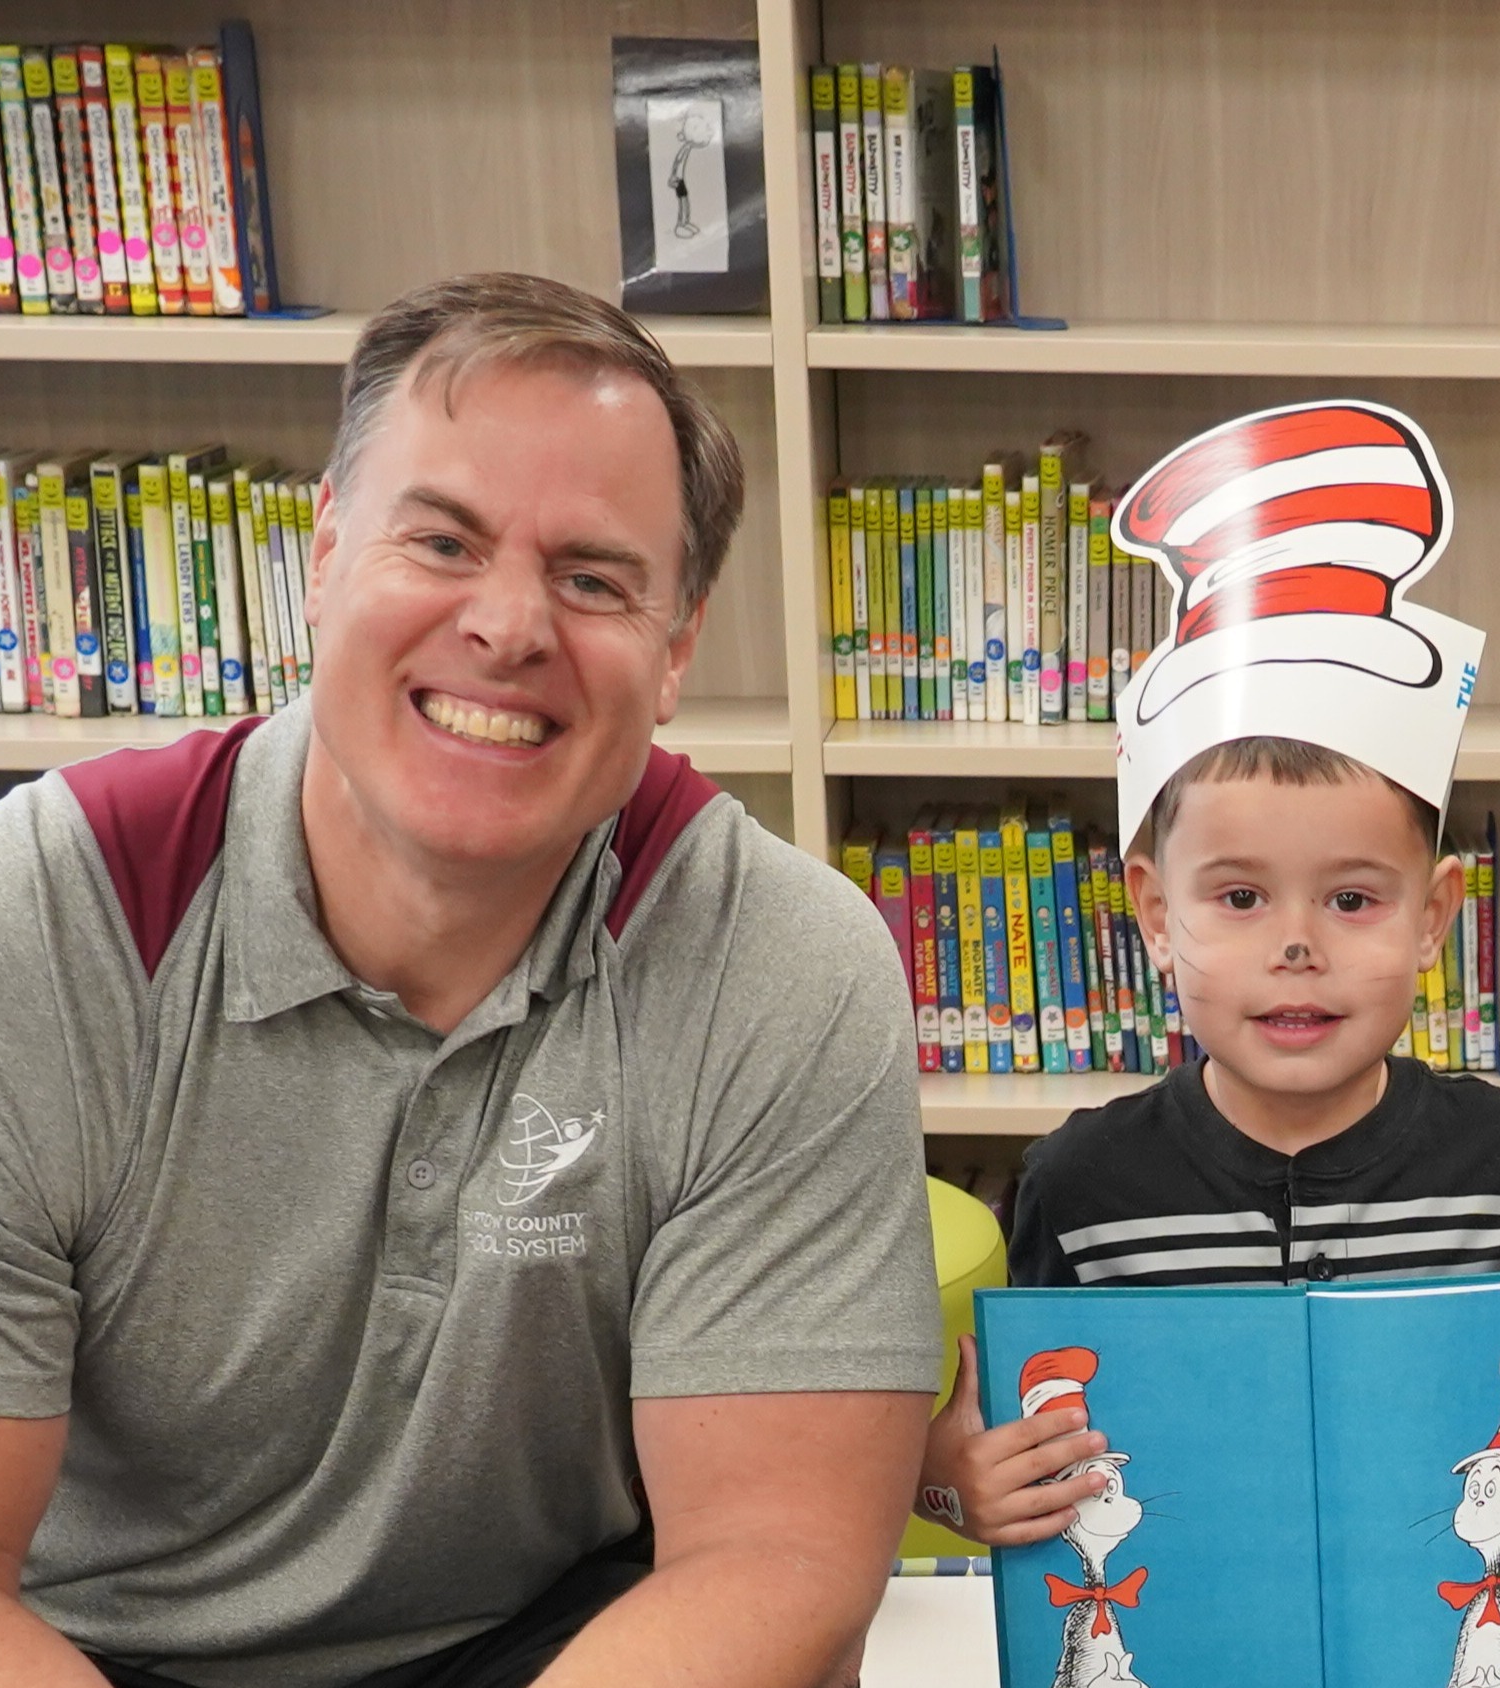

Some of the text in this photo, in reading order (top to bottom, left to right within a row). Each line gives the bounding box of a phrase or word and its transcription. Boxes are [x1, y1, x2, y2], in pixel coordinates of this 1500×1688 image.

[1044, 516, 1057, 616] HOMER PRICE
[182, 592, 194, 624] NEWS
[1011, 914, 1027, 968] NATE
[973, 965, 983, 997] NATE
[506, 1212, 586, 1232] COUNTY
[507, 1235, 587, 1257] SYSTEM
